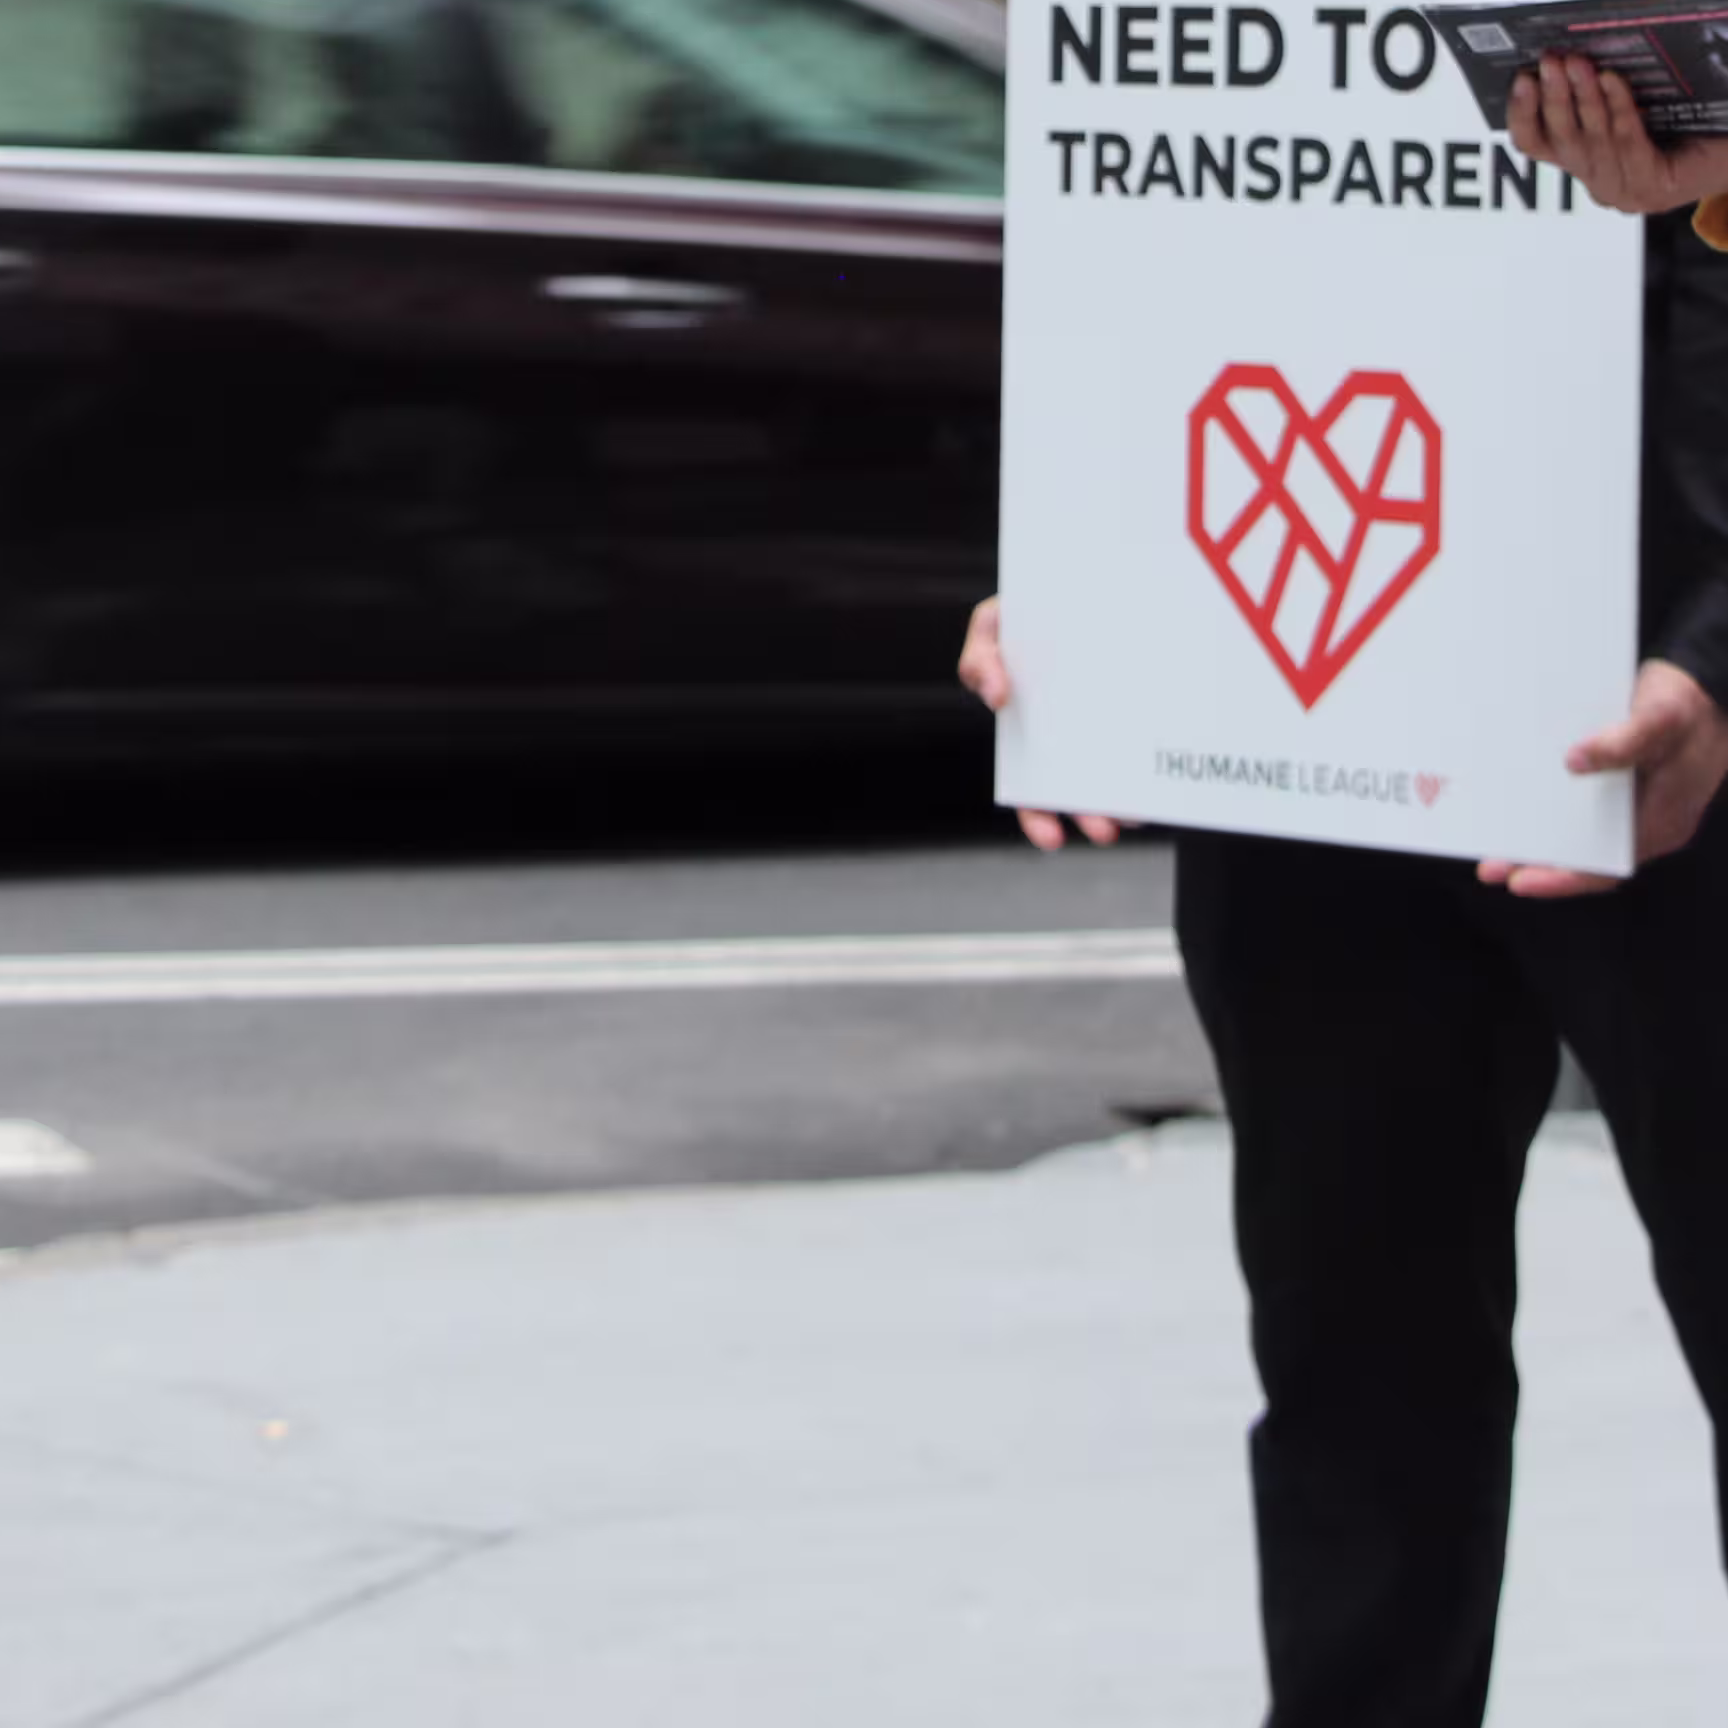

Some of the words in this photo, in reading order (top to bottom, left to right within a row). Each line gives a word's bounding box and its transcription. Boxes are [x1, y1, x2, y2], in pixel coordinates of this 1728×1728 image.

[1050, 4, 1285, 88] NEED
[1315, 6, 1436, 92] TO
[1166, 753, 1291, 791] HUMANE
[1297, 763, 1410, 805] LEAGUE
